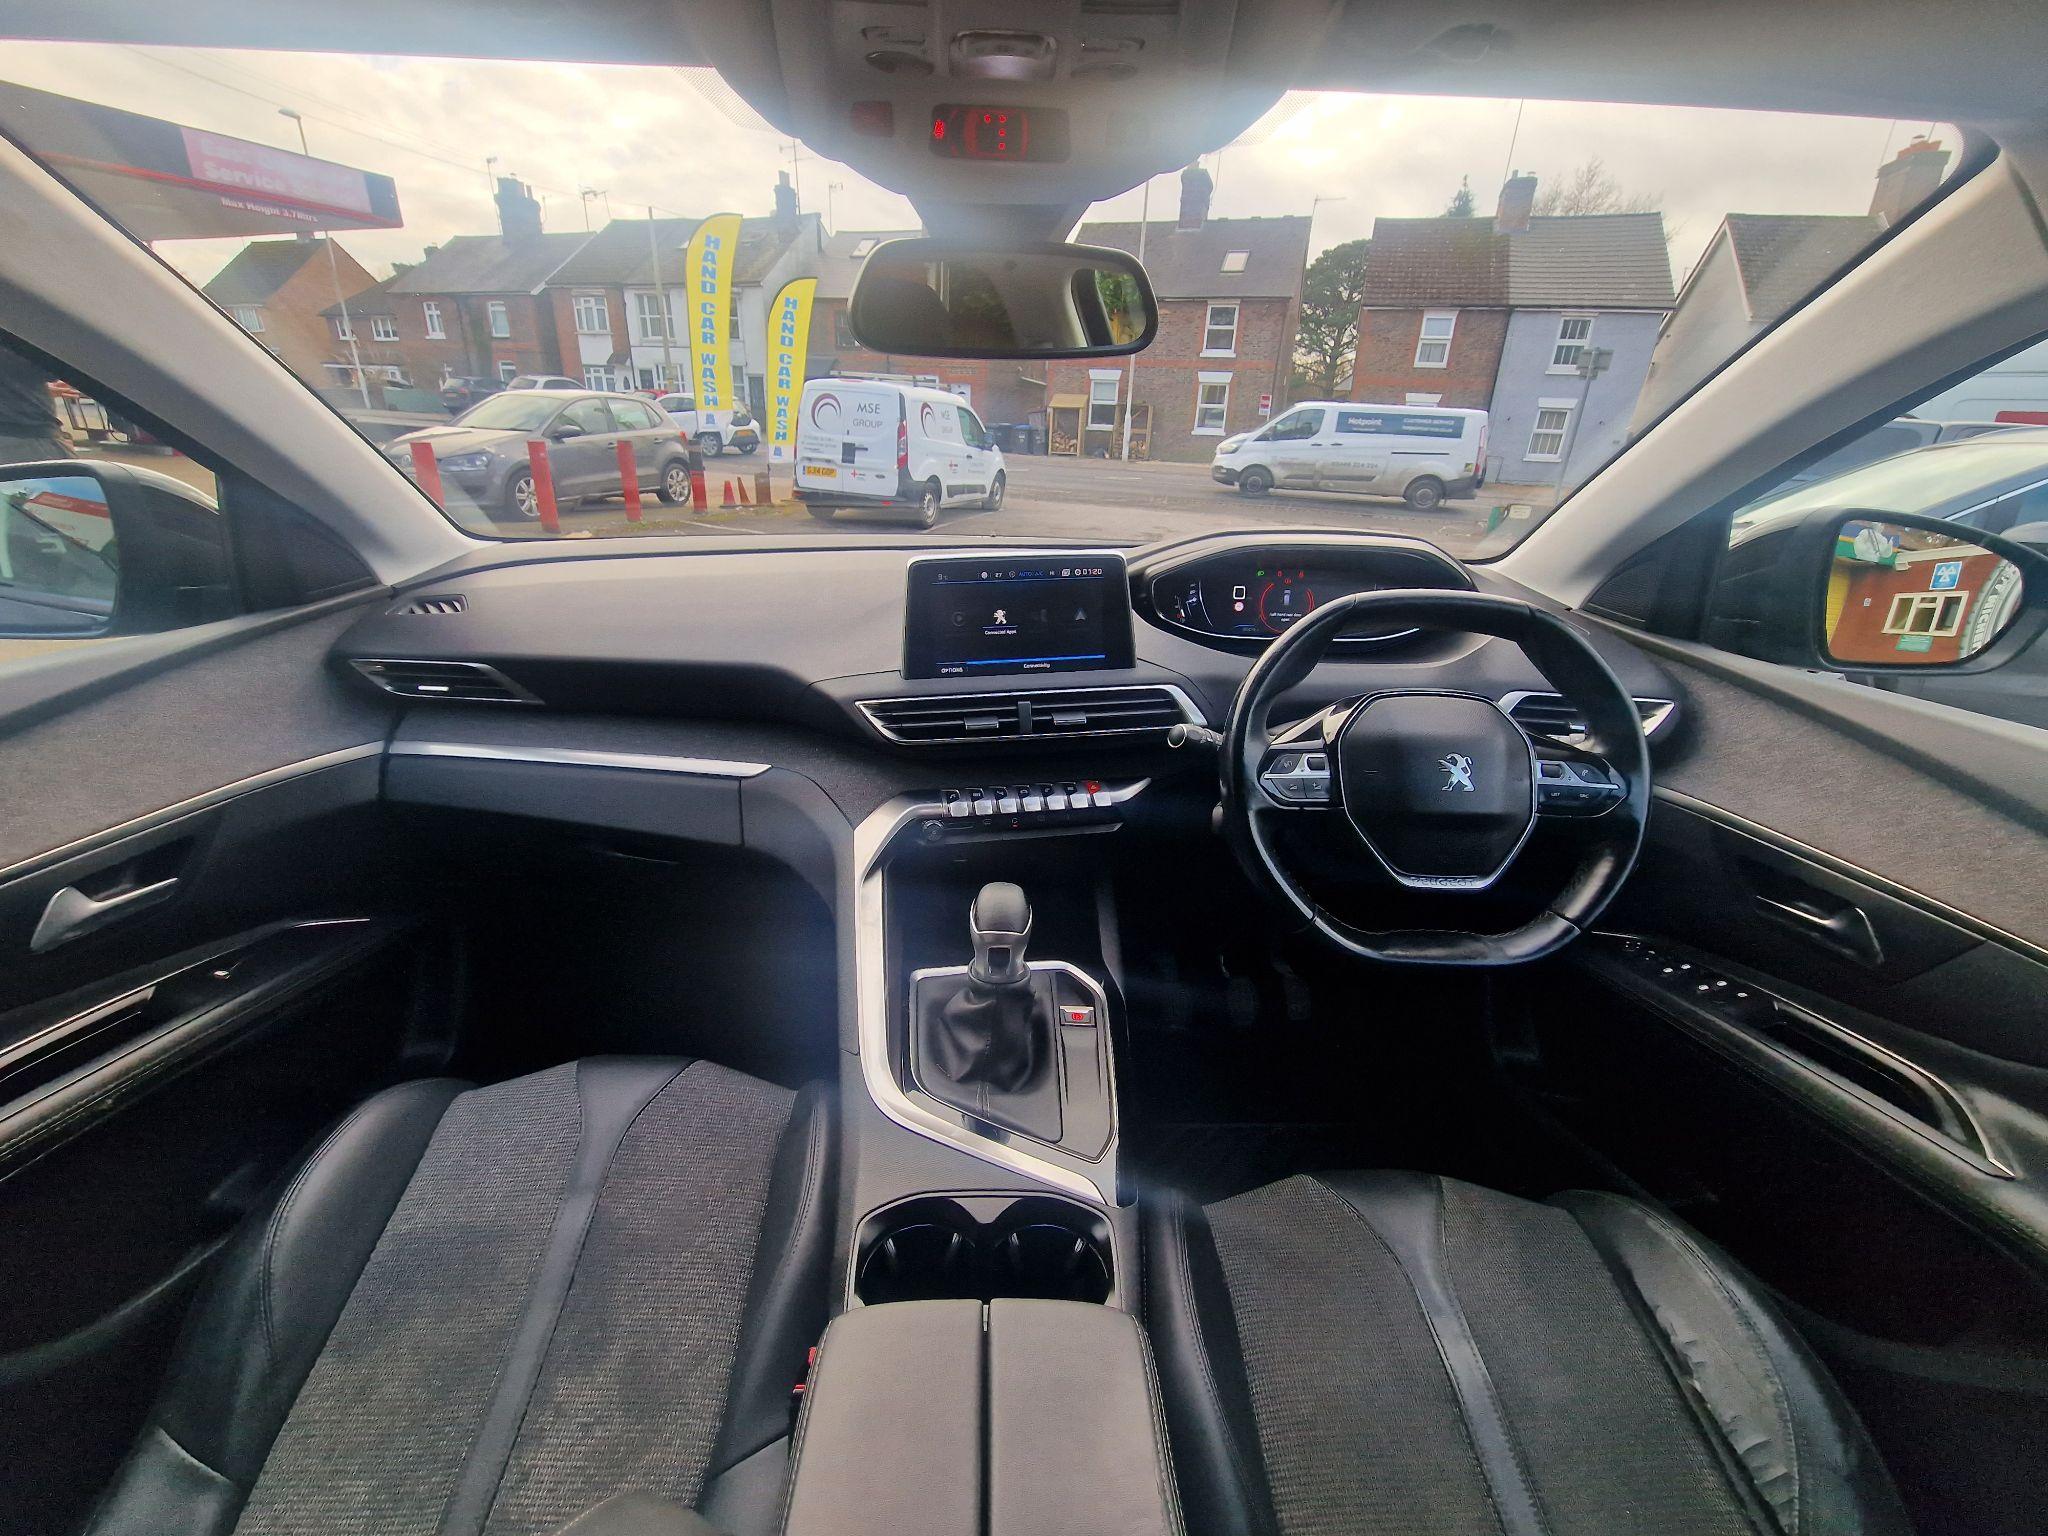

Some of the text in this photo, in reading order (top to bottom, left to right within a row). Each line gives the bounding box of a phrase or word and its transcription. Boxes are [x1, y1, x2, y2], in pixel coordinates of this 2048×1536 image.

[247, 202, 281, 217] Height
[700, 234, 721, 406] HAND CAR WASH
[774, 297, 798, 441] HAND CAR WASH
[856, 403, 881, 415] MSE
[852, 419, 884, 429] GROUP
[1347, 417, 1383, 428] Hotpoint
[1410, 877, 1474, 887] PEUGEOT
